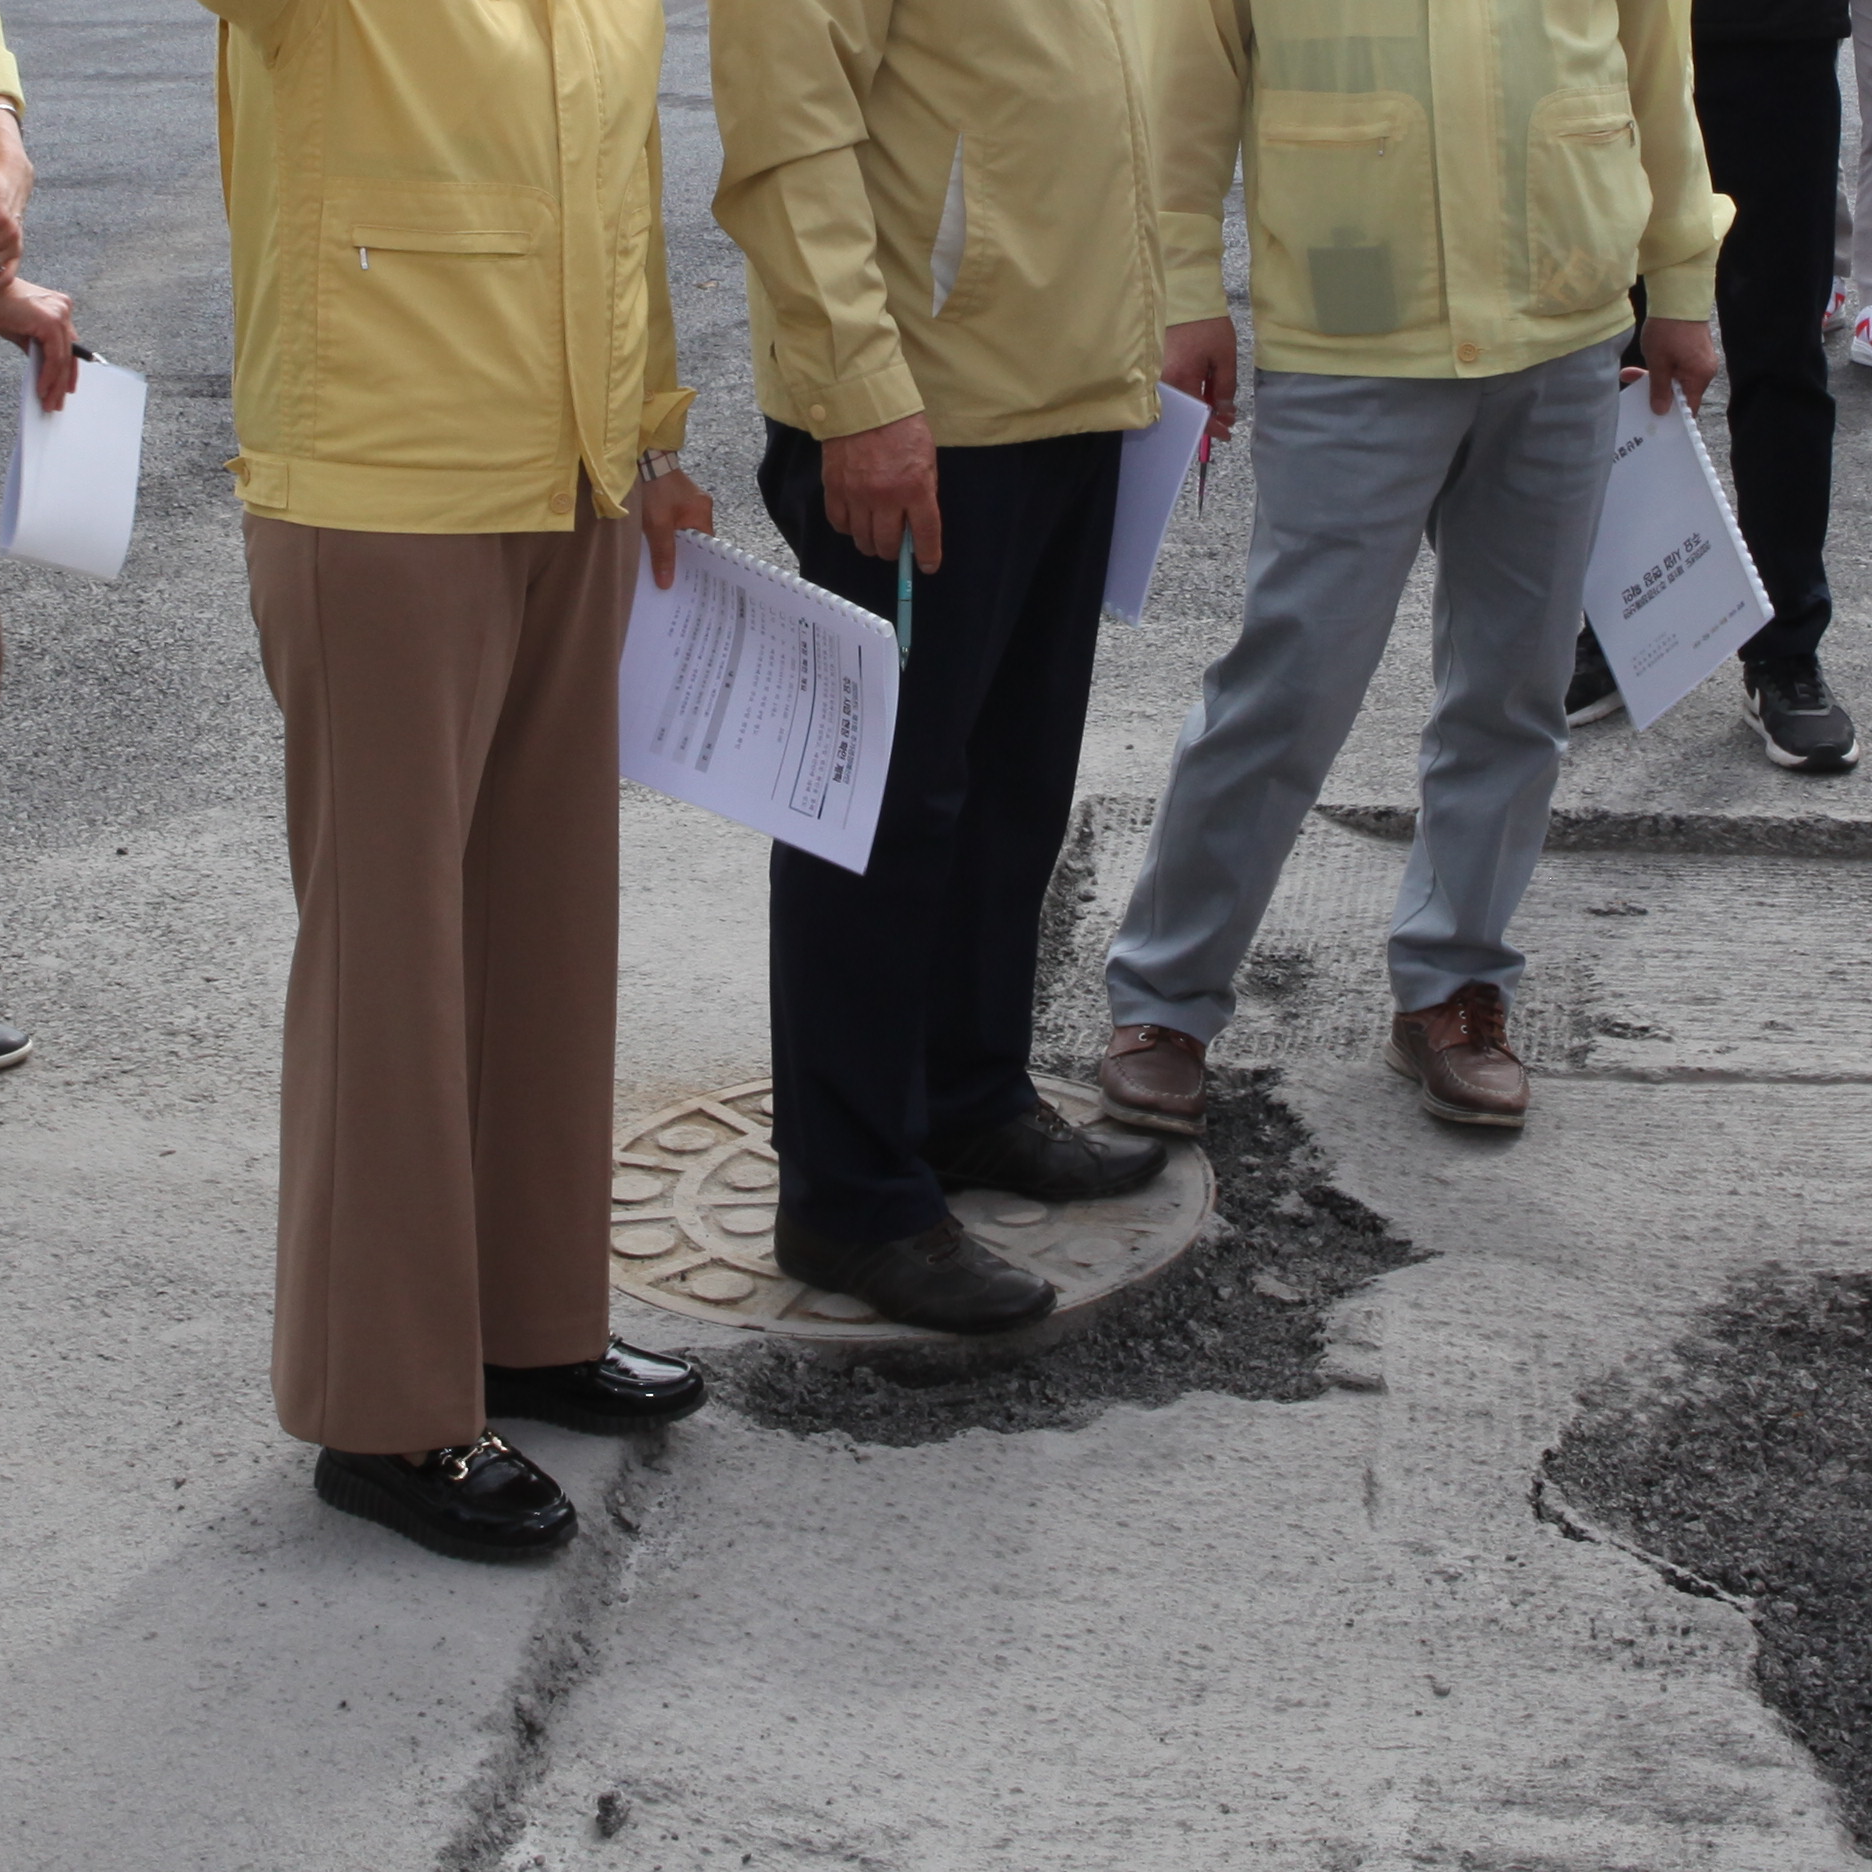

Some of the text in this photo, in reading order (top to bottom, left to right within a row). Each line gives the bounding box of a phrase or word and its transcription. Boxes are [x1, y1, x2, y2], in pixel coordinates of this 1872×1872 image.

[1620, 533, 1703, 605] 주요 사업 현장 확인
